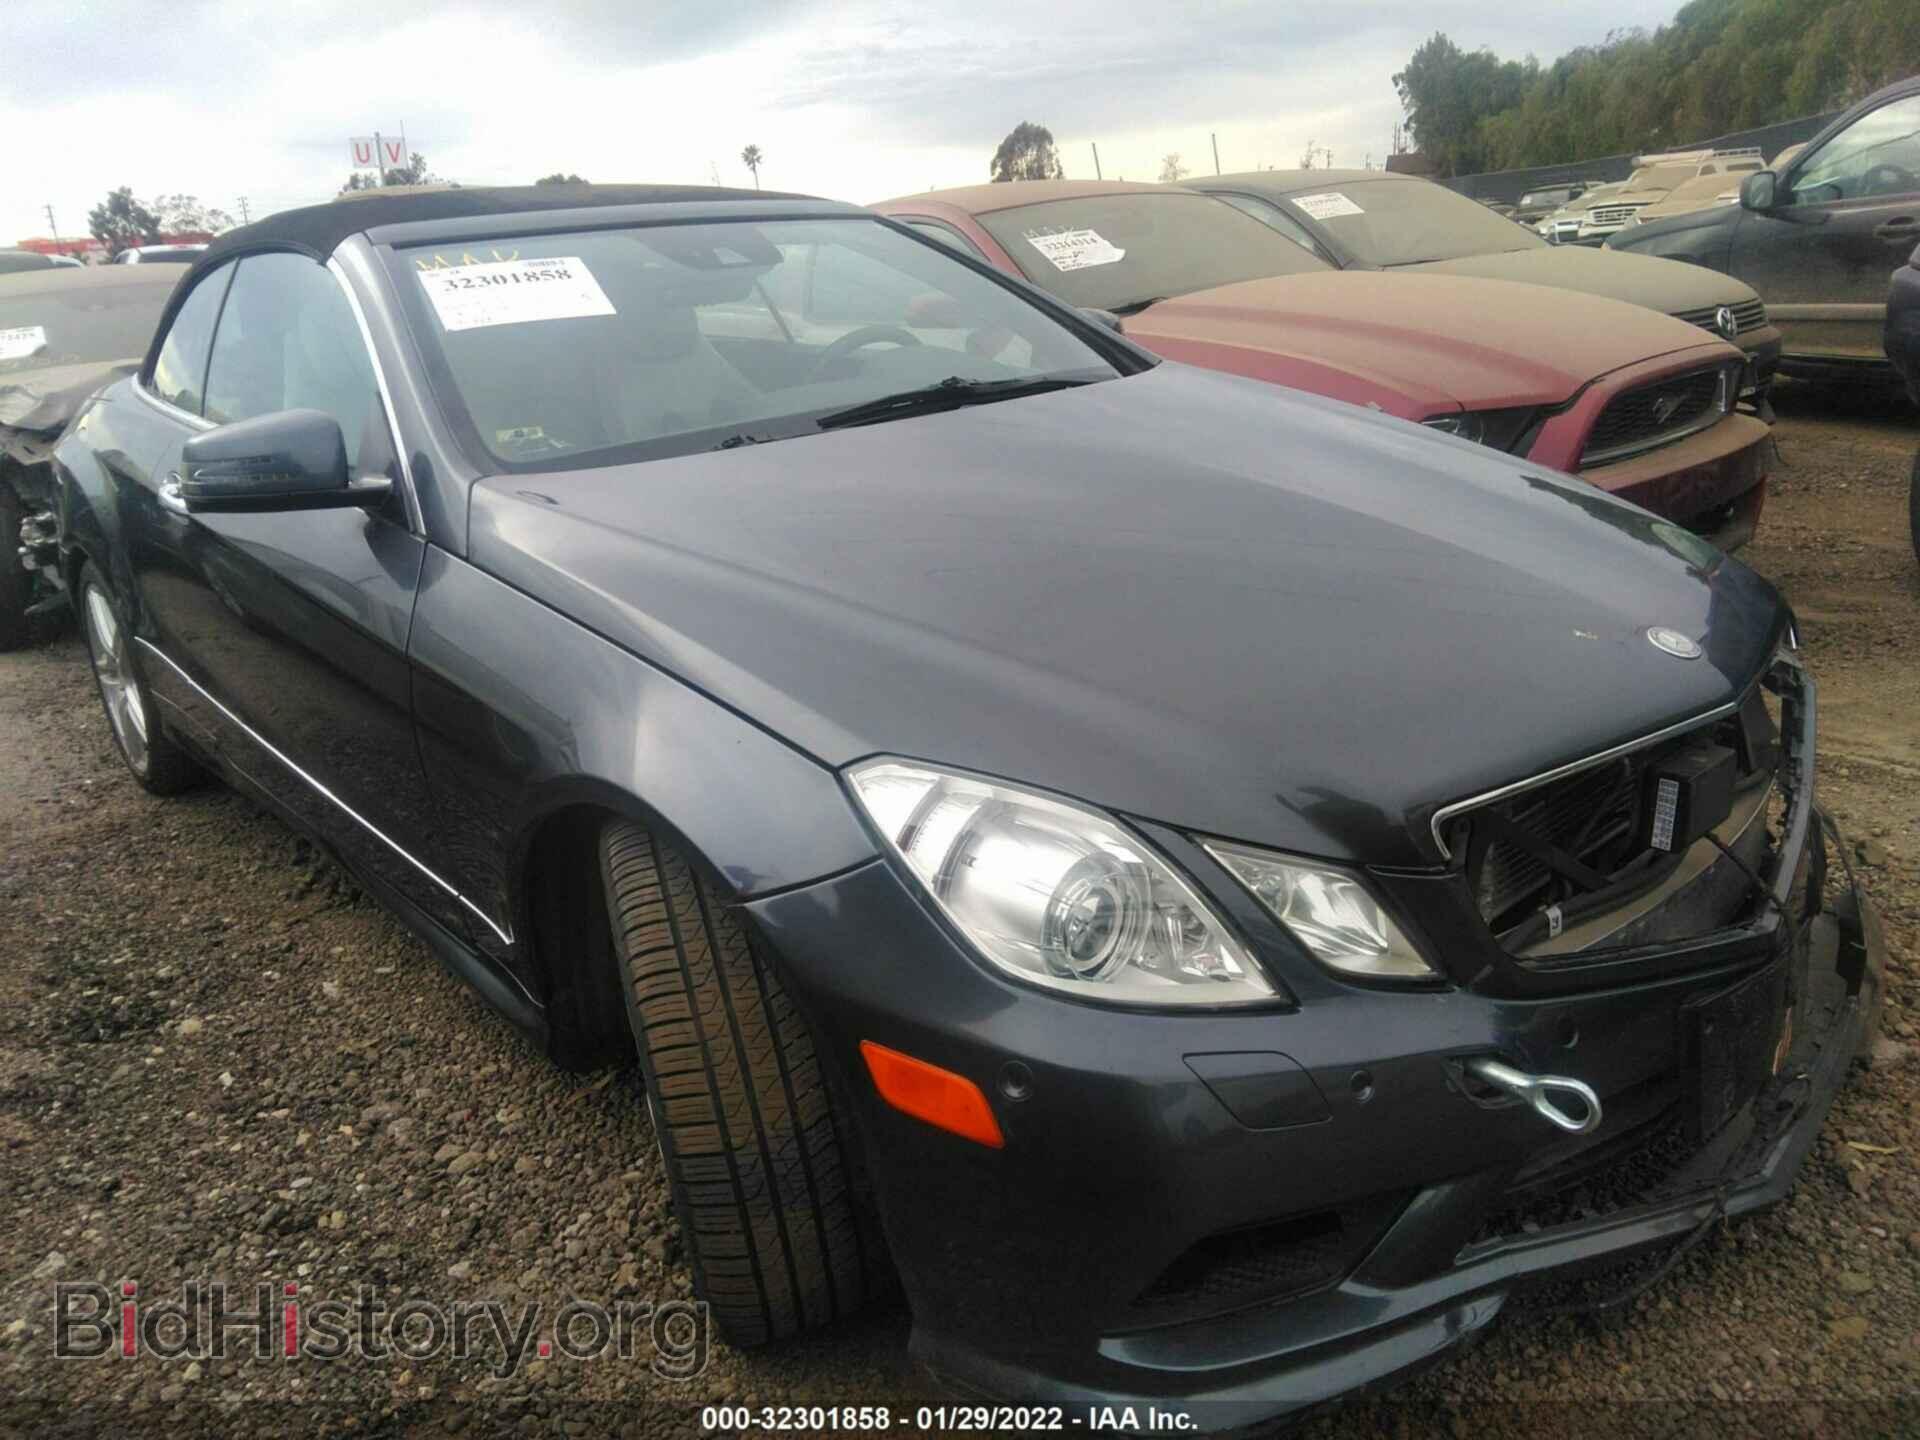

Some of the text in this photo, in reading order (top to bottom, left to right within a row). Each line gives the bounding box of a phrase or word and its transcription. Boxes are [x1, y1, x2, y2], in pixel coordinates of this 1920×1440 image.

[355, 143, 401, 165] U V
[443, 267, 573, 293] 32301858
